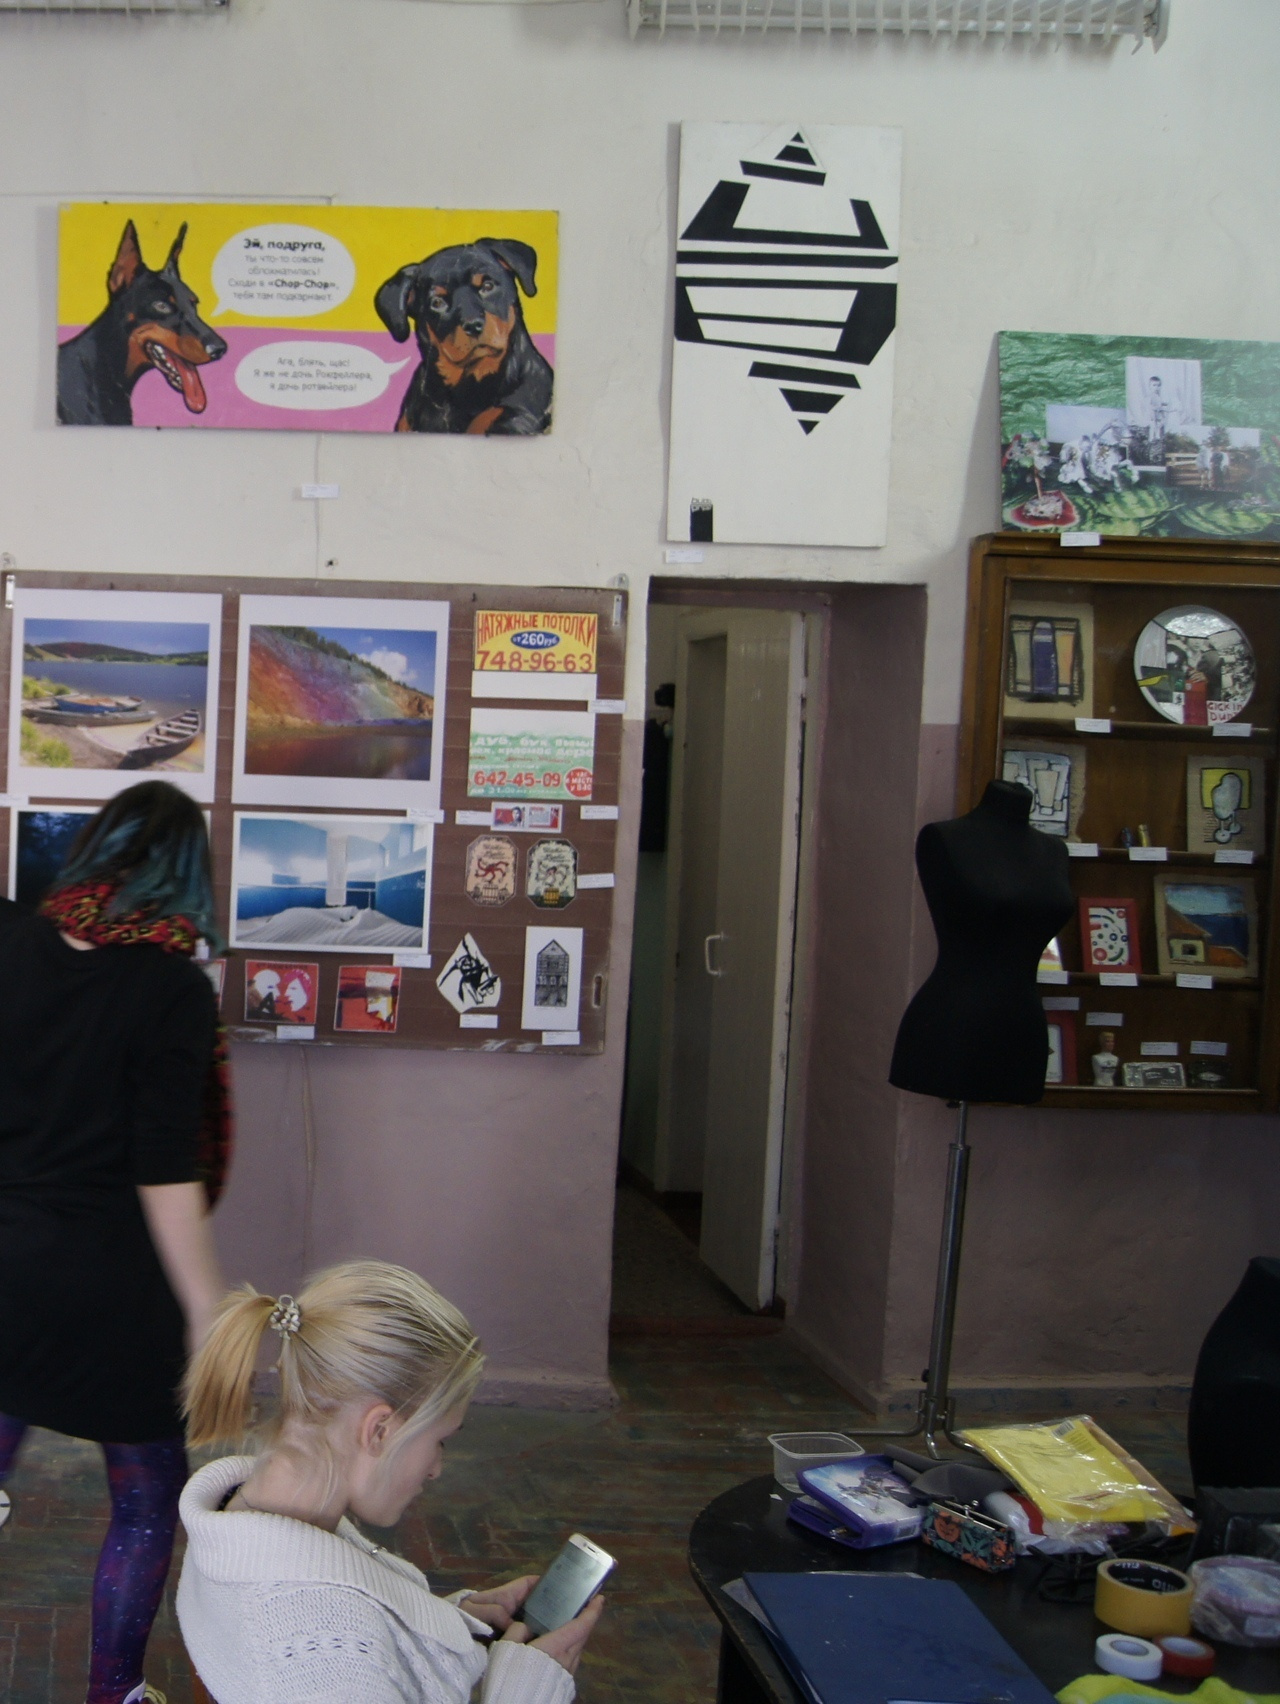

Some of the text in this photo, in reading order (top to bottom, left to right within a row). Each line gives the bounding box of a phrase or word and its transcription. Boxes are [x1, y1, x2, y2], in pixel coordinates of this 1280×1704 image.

[267, 240, 326, 251] подруга,
[477, 613, 597, 654] НАТЯЖНЫЕ ПОТОЛКИ
[476, 650, 593, 672] 748-96-63
[474, 770, 561, 788] 642-45-09
